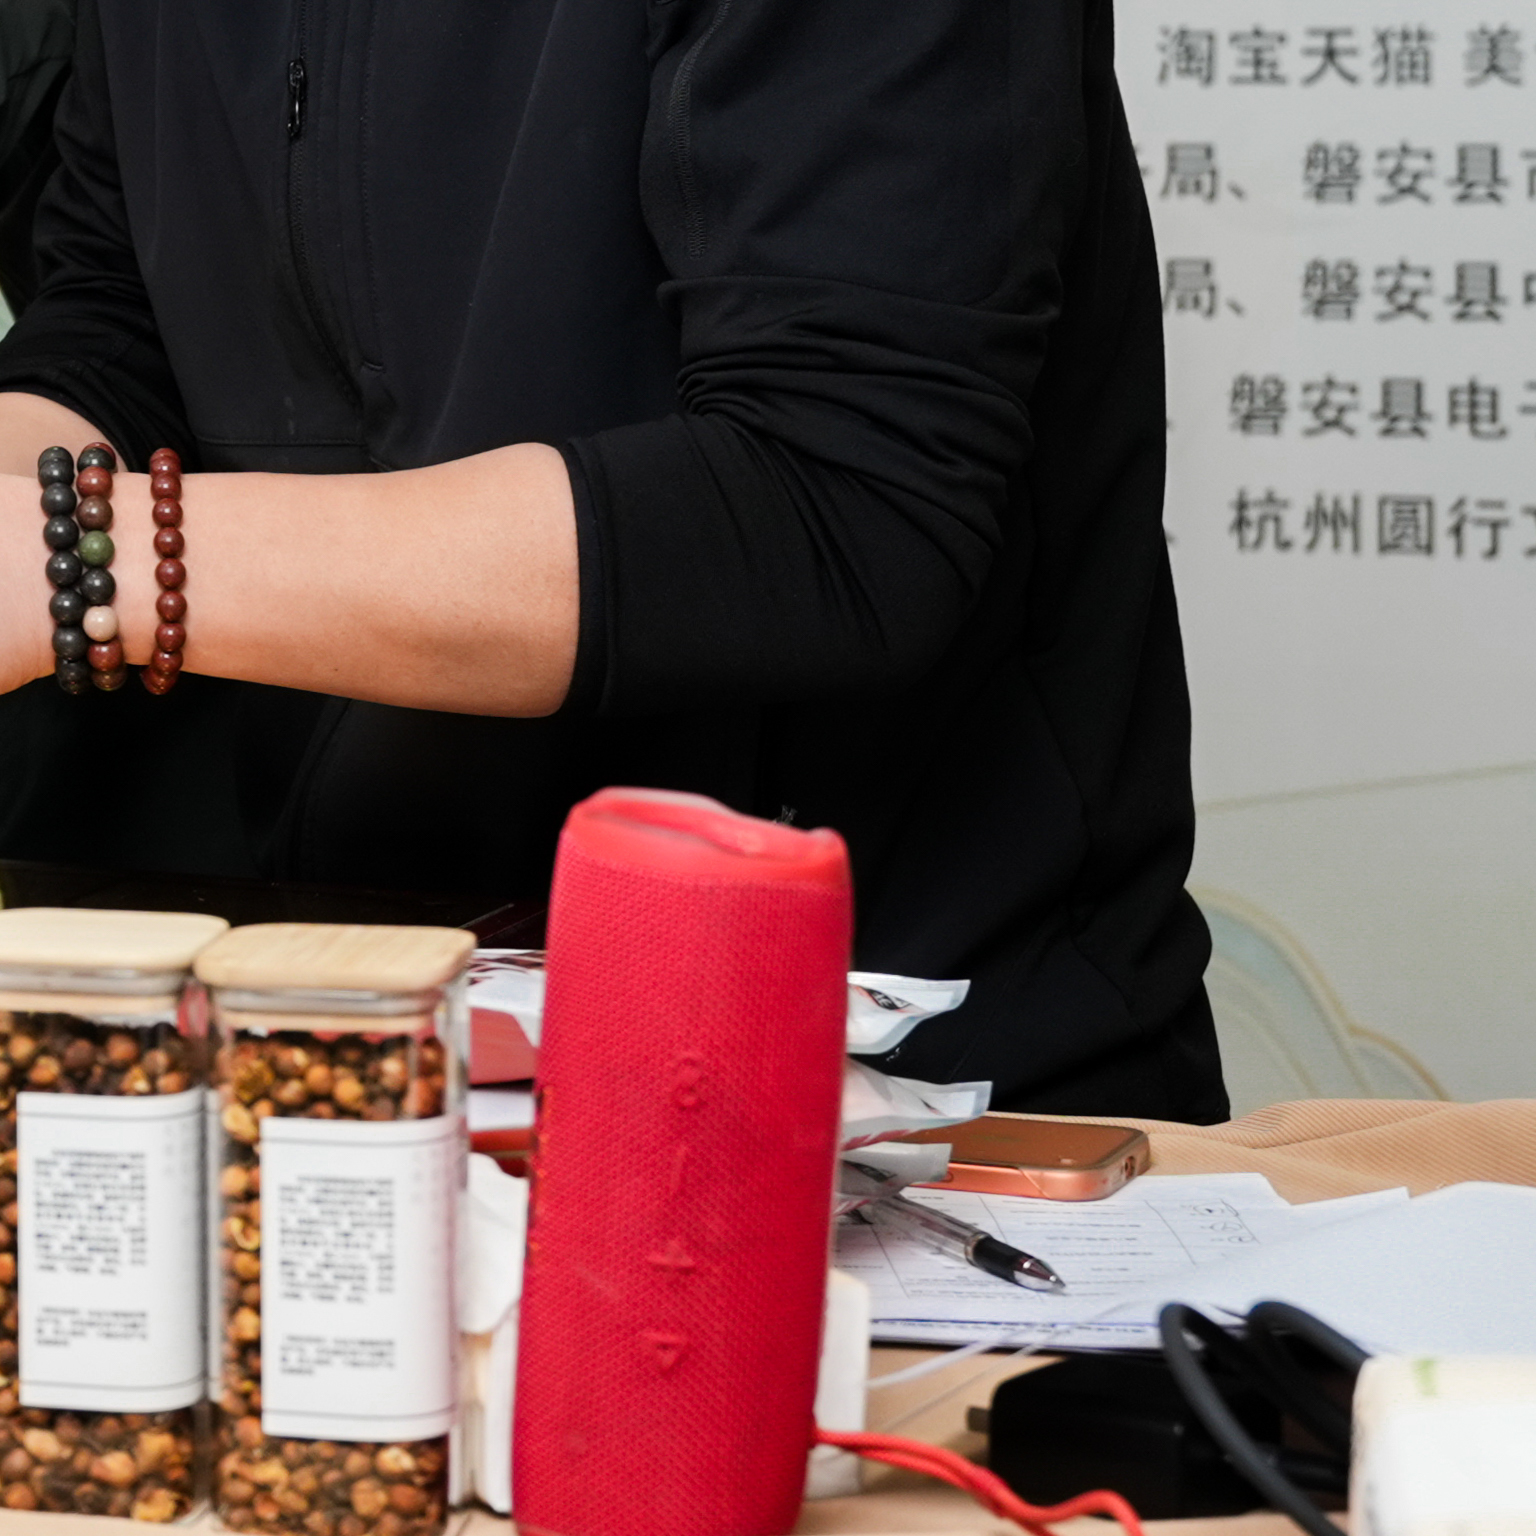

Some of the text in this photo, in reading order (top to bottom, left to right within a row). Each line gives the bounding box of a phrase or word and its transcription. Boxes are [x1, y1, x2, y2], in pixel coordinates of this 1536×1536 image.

[1155, 23, 1536, 88] 淘宝天猫 美
[1135, 138, 1536, 206] 局、磐安县
[1162, 257, 1536, 324] 局、磐安县
[1168, 373, 1536, 441] 磐安县电
[1166, 487, 1536, 560] 杭州圆行
